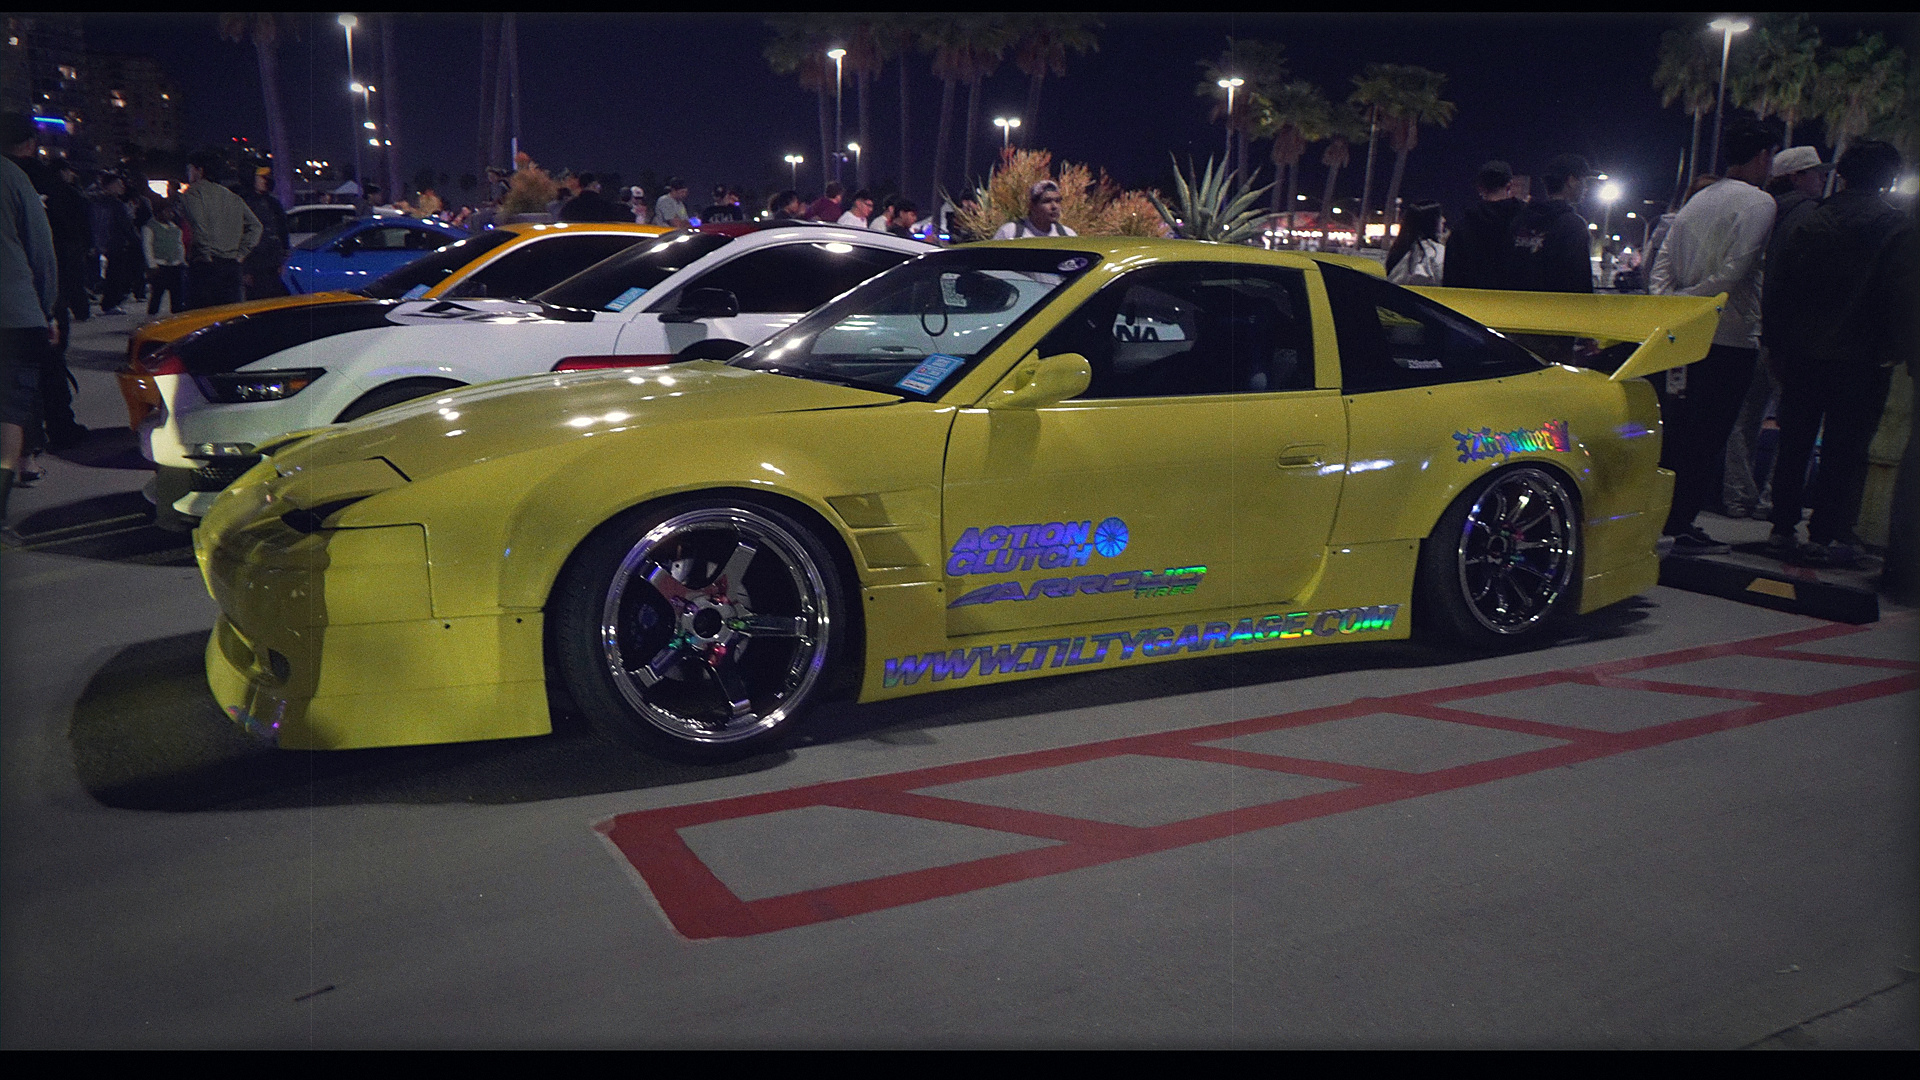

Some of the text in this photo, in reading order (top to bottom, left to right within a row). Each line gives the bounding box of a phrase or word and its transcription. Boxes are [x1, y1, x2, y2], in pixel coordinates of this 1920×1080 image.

[950, 520, 1092, 553] ACTION
[945, 543, 1094, 577] CLUTCH
[883, 603, 1400, 689] WWW.TILTYGARAGE.COM
